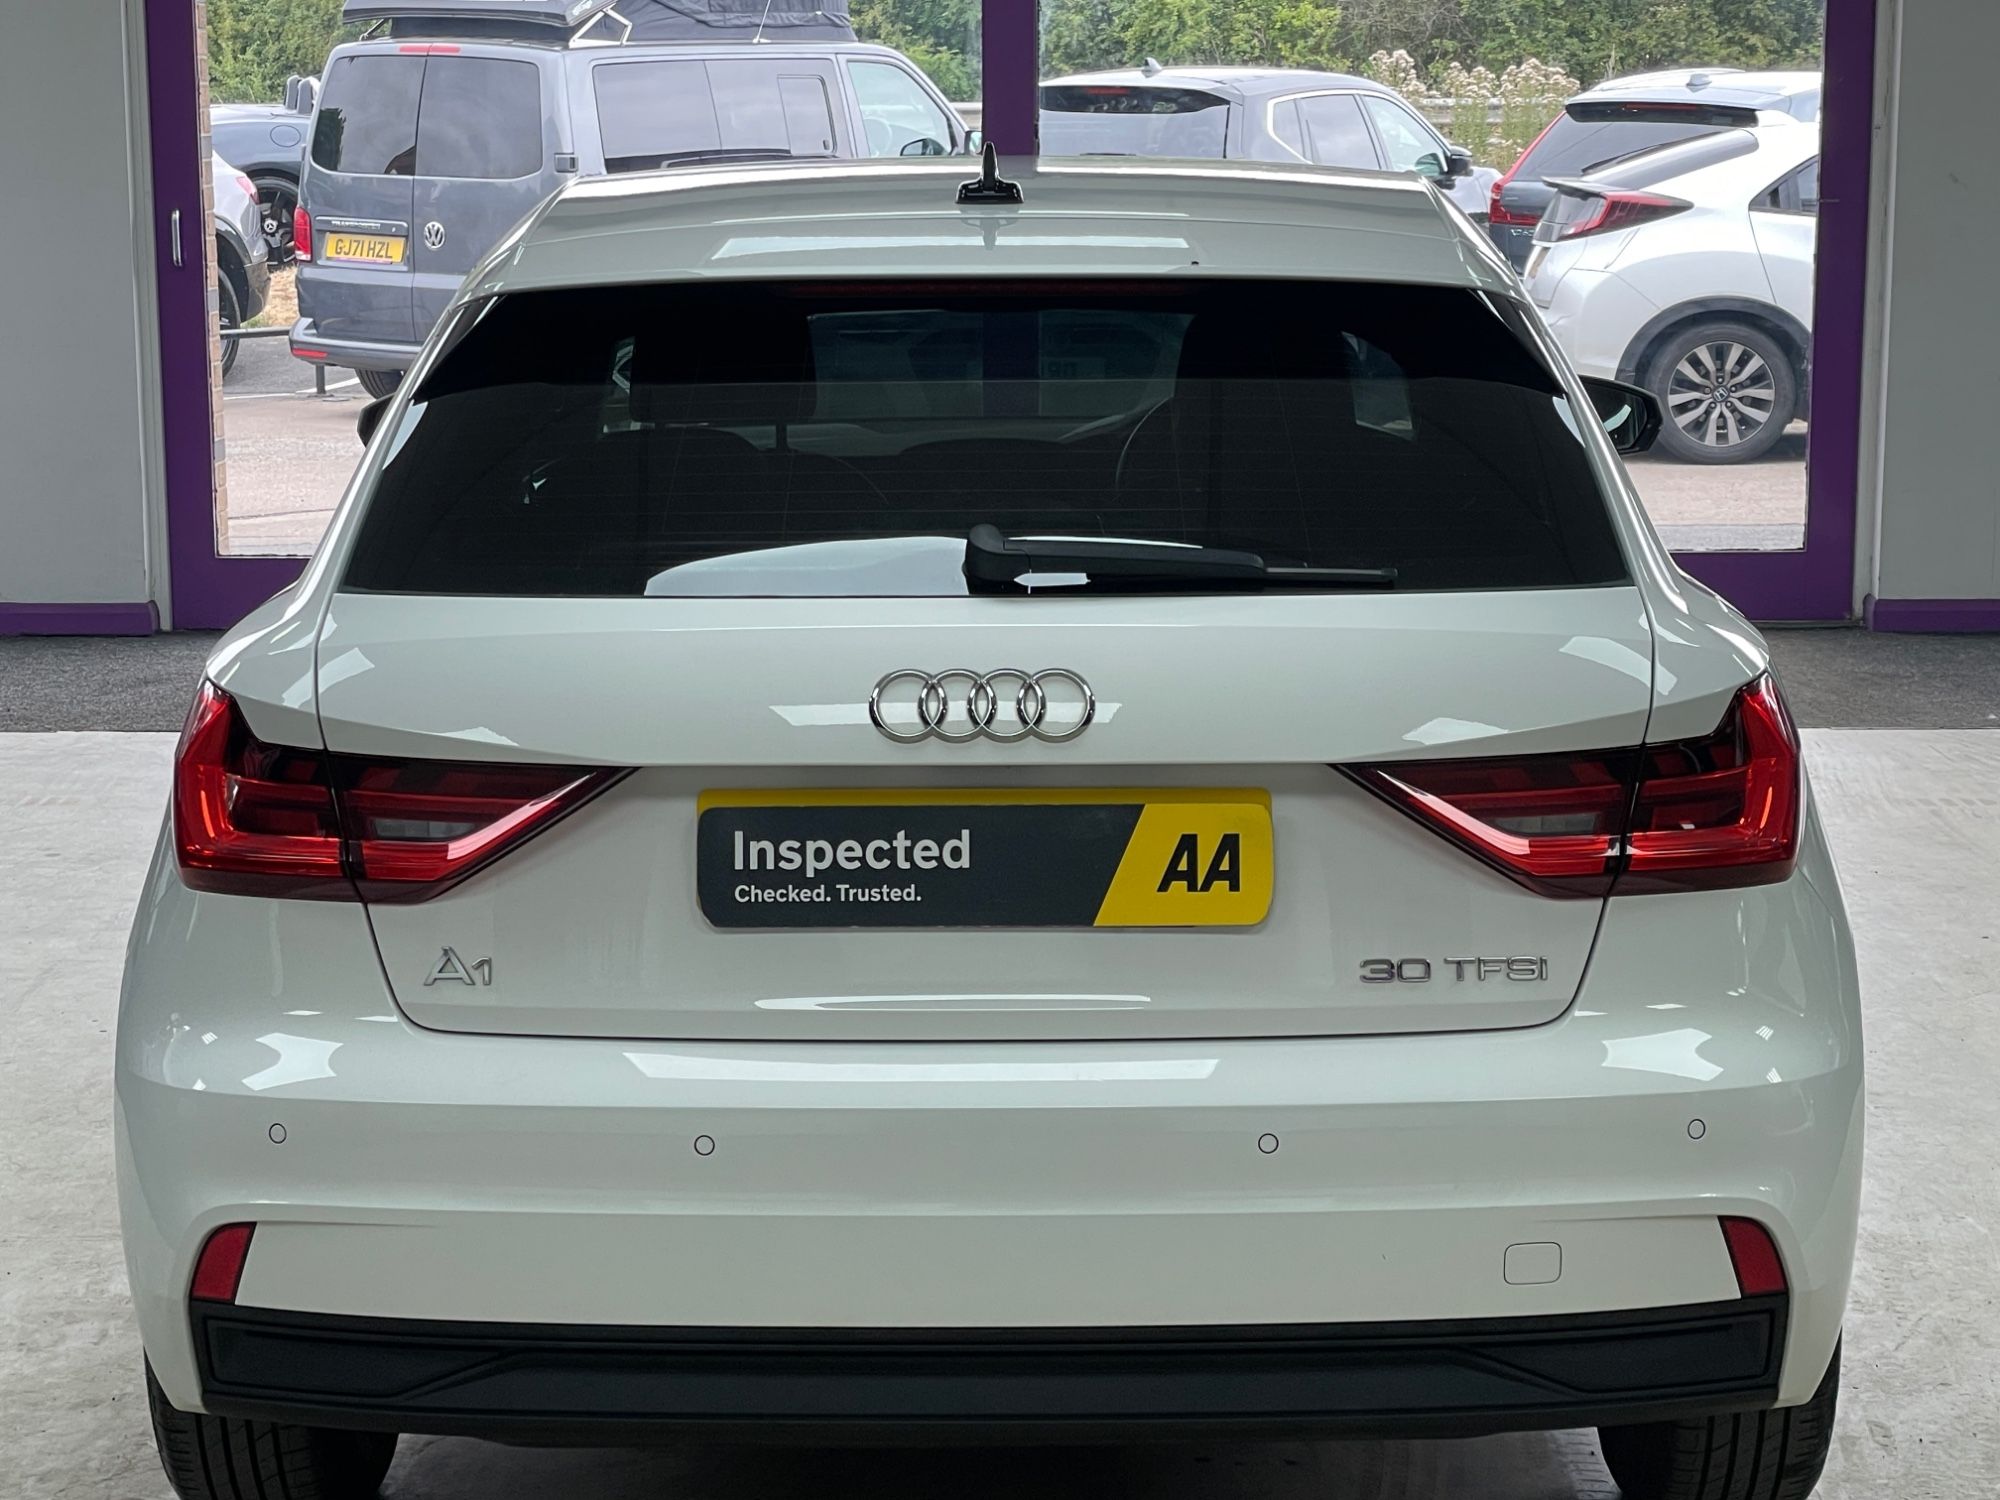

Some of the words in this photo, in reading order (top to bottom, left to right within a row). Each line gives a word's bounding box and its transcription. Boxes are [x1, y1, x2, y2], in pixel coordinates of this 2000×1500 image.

[335, 239, 365, 257] GJ71
[366, 240, 393, 259] HZL
[733, 829, 971, 878] Inspected
[1157, 833, 1241, 893] AA
[734, 884, 831, 903] Checked.
[836, 884, 922, 903] Trusted.
[424, 946, 492, 986] A1
[1360, 957, 1431, 983] 30
[1444, 956, 1549, 982] TFSI
